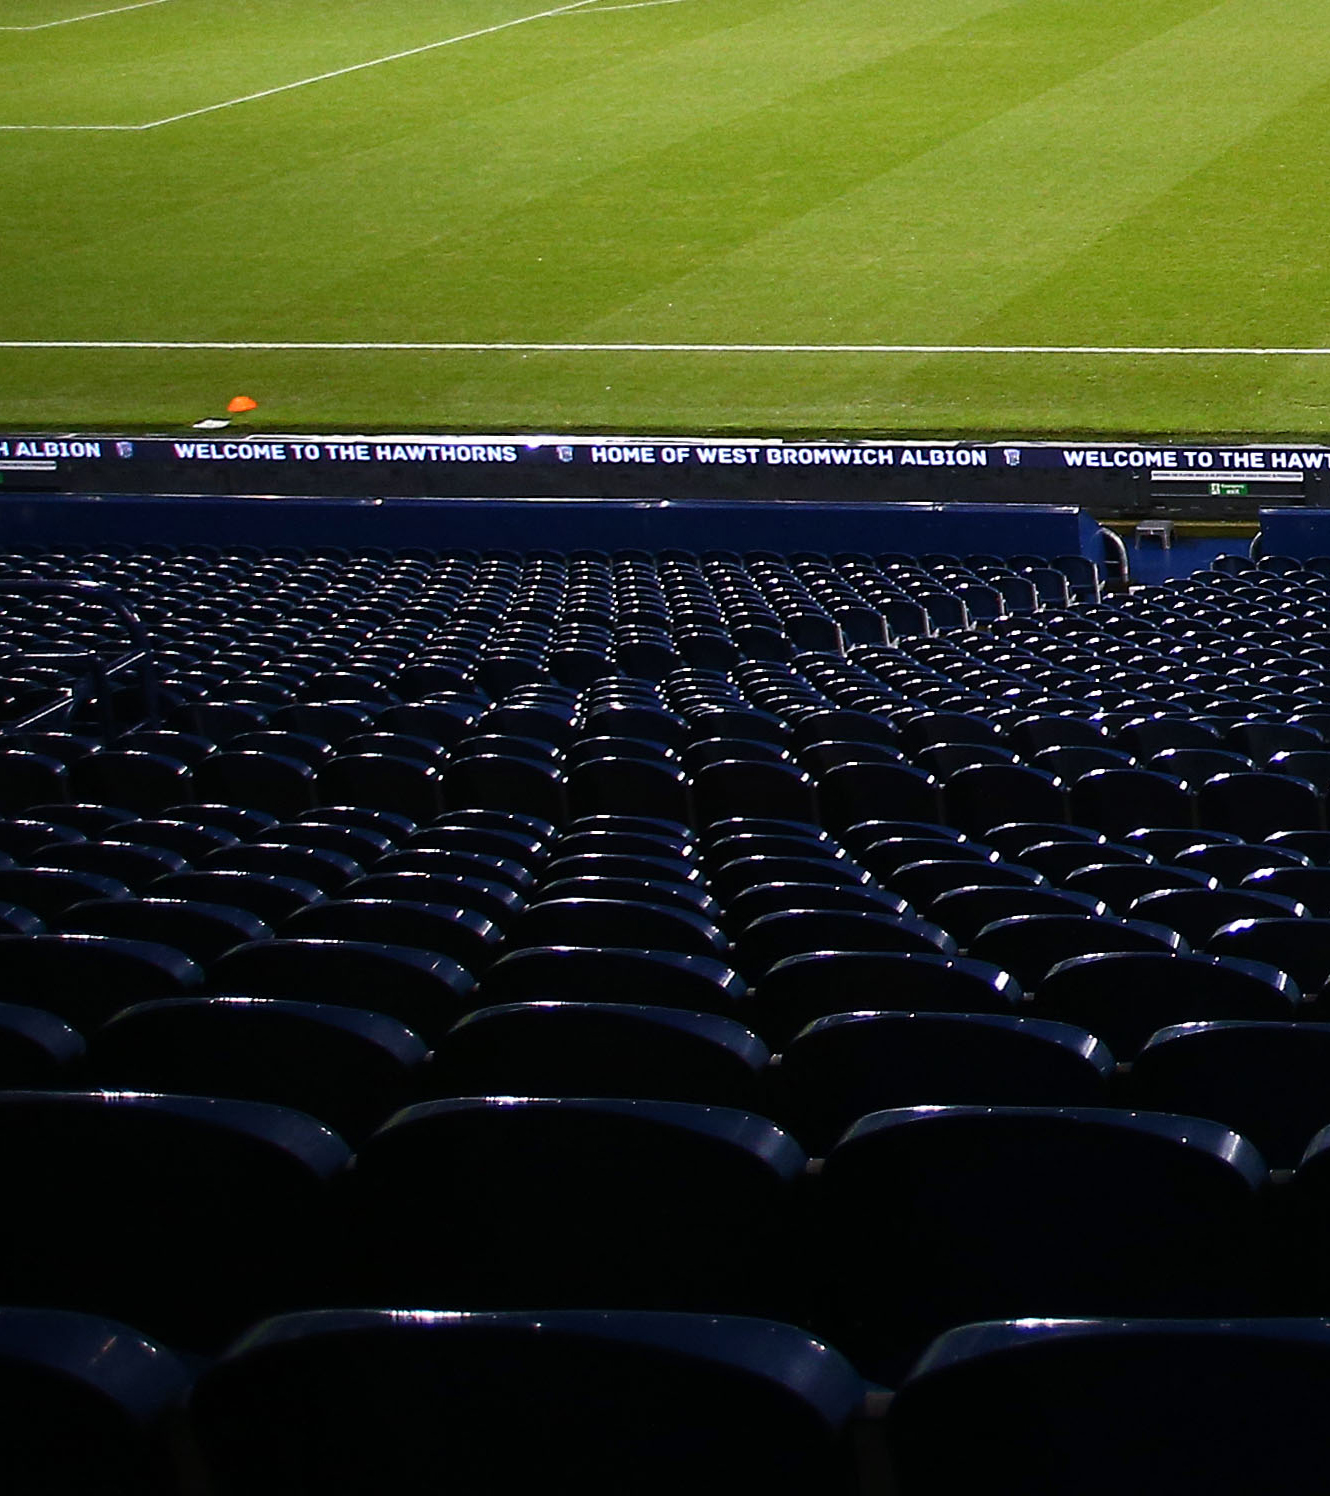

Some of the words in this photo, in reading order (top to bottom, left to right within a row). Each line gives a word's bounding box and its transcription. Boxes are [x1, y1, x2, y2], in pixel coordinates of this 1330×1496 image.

[16, 442, 100, 457] ALBION
[175, 444, 286, 459] WELCOME
[291, 445, 319, 459] TO
[325, 445, 370, 460] THE
[376, 446, 516, 461] HAWTHORNS
[592, 447, 655, 462] HOME
[662, 448, 689, 462] OF
[696, 448, 759, 463] WEST
[767, 449, 893, 464] BROMWICH
[901, 450, 986, 465] ALBION
[1064, 451, 1177, 466] WELCOME
[1184, 452, 1212, 467] TO
[1220, 452, 1264, 467] THE
